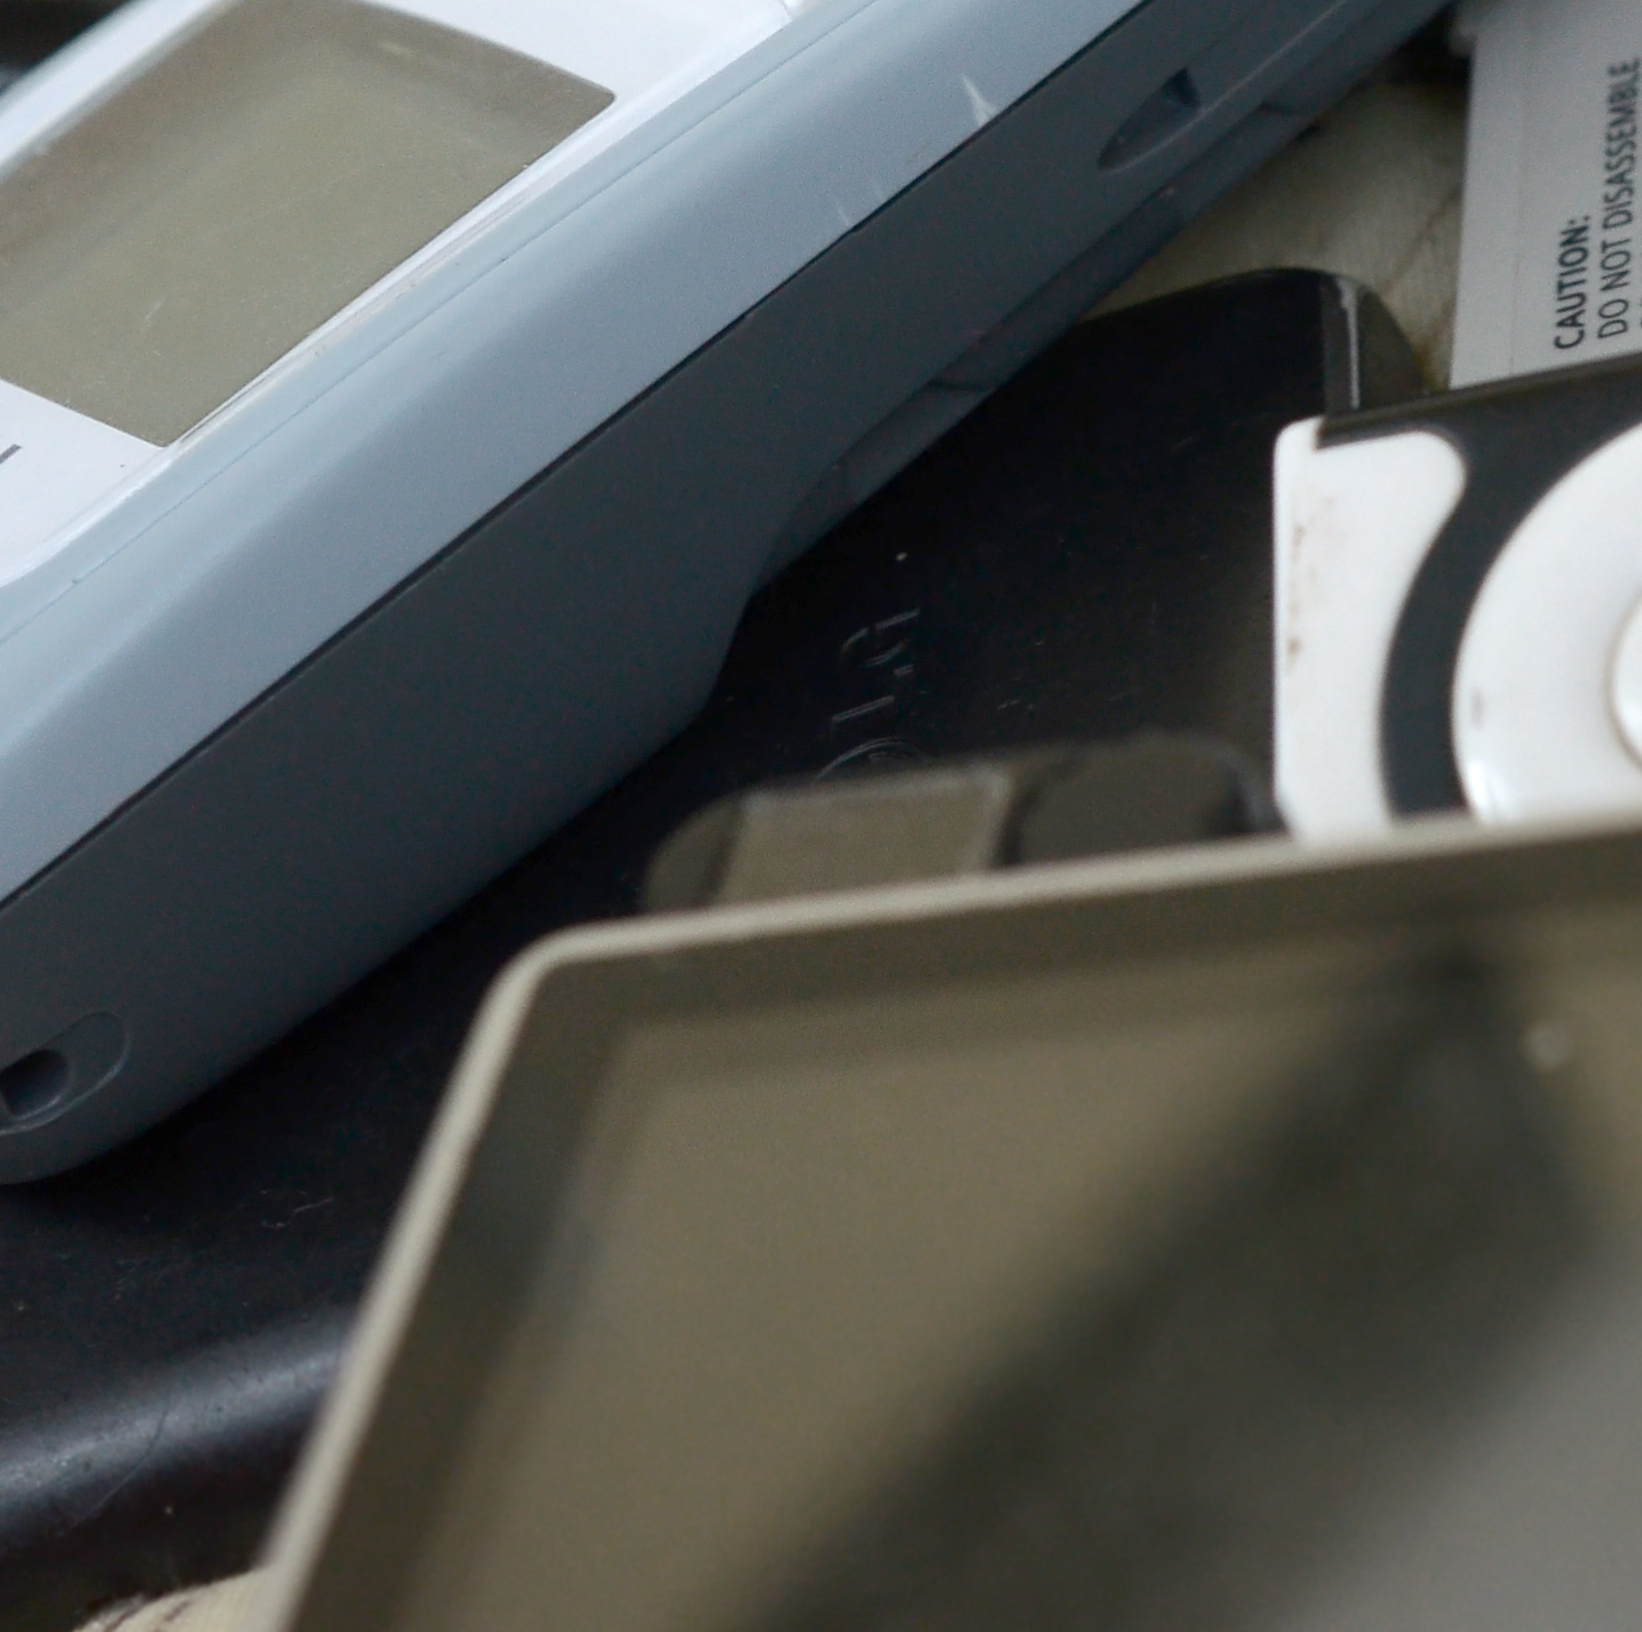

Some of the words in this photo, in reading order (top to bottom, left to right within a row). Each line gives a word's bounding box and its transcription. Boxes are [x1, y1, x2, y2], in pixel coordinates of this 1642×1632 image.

[1602, 57, 1640, 229] DISASSEMBLE
[1553, 215, 1590, 349] CAUTION:
[1600, 237, 1631, 292] NOT
[1597, 299, 1629, 339] DO
